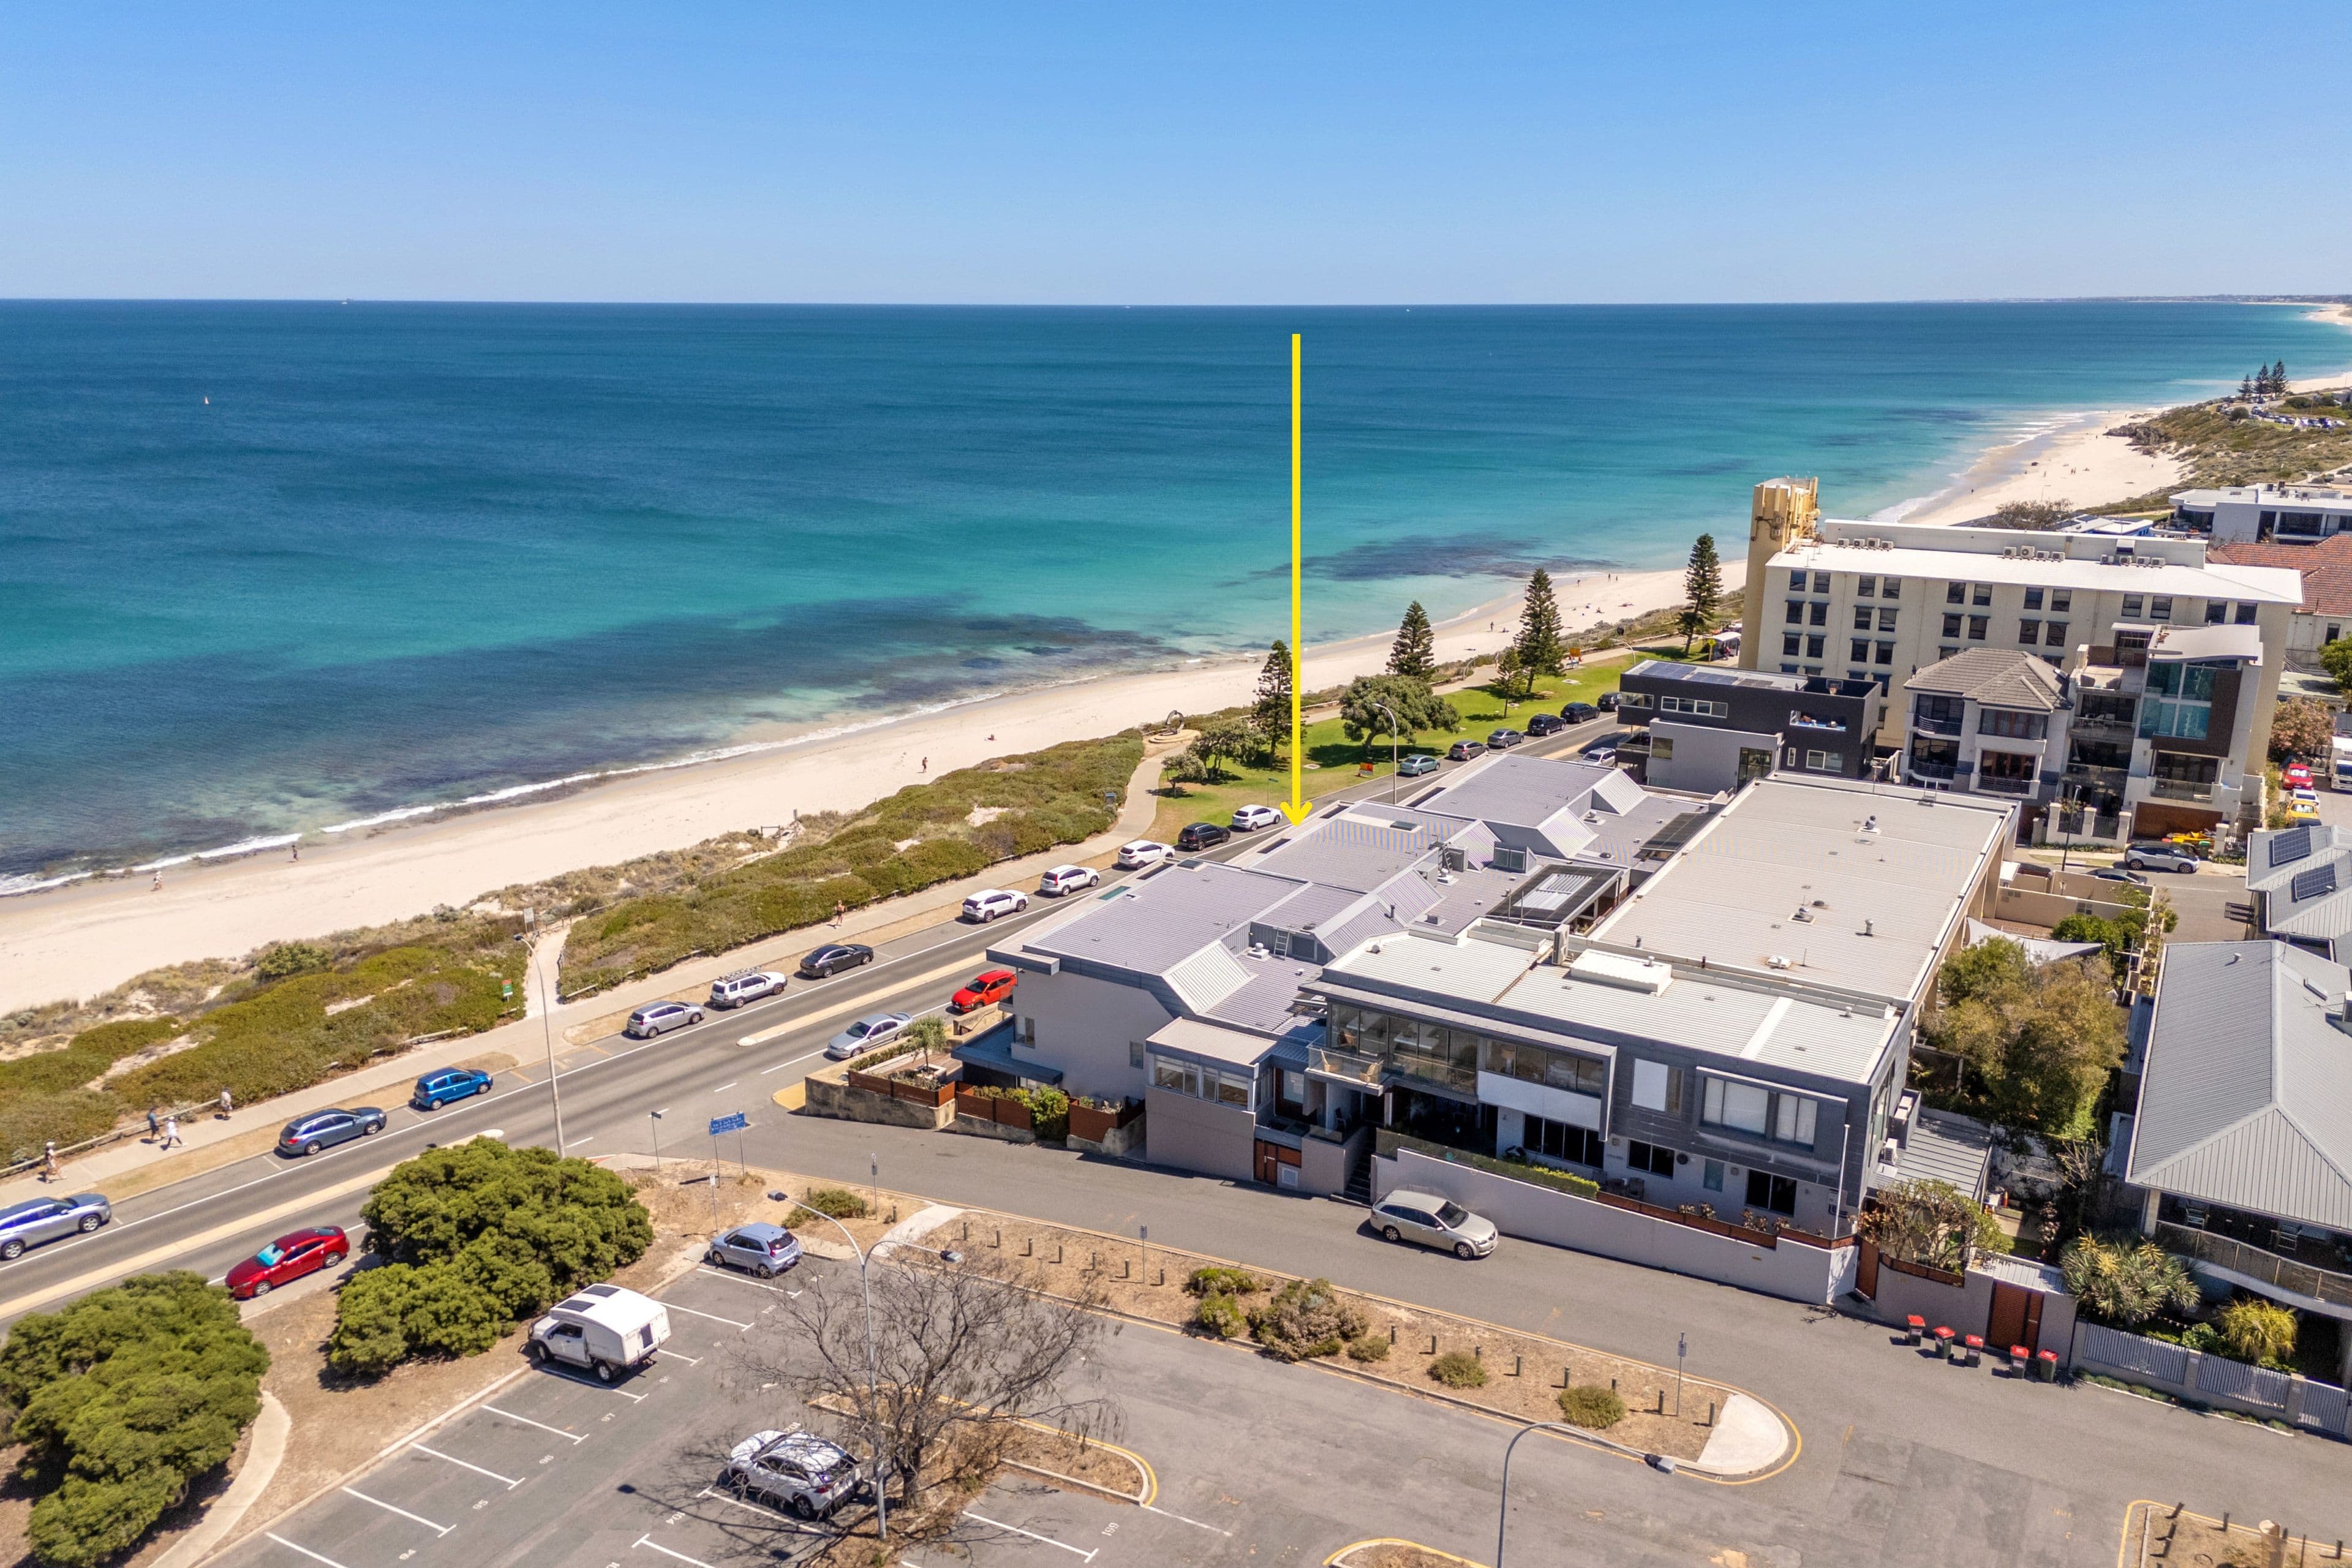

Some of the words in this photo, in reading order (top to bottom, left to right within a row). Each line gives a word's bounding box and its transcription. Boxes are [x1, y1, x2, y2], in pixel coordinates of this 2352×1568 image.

[472, 1499, 489, 1509] 95
[666, 1511, 685, 1524] 104
[398, 1549, 416, 1560] 94
